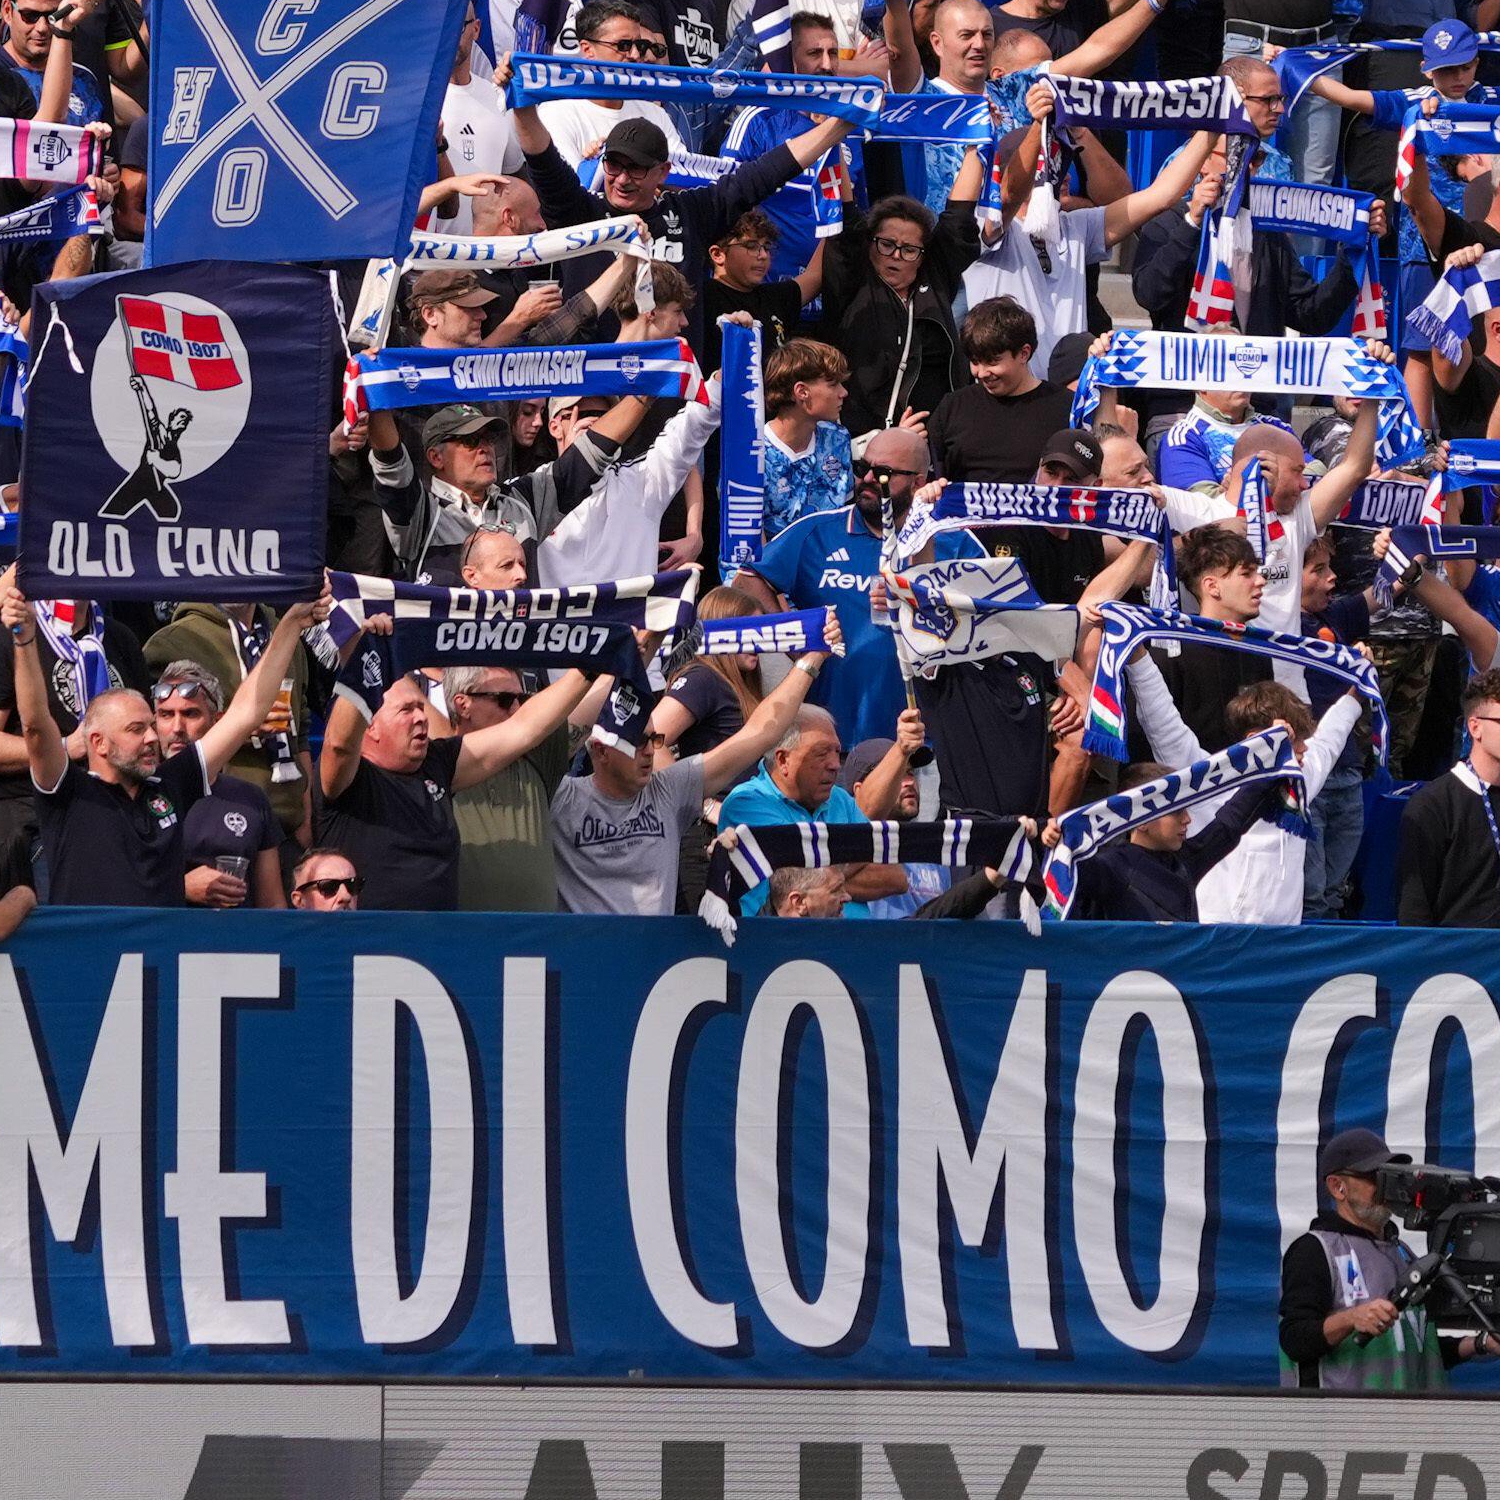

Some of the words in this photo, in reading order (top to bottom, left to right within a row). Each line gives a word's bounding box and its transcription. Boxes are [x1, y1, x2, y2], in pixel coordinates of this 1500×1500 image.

[523, 61, 682, 89] ULTRAS
[322, 61, 386, 139] C
[141, 330, 183, 353] COMO
[187, 341, 221, 358] 1907
[1160, 337, 1226, 381] COMO
[1276, 341, 1331, 386] 1907
[453, 353, 502, 389] SEMM
[502, 350, 586, 386] CUMASCH
[965, 484, 1060, 517] AVANTI
[48, 521, 134, 576] OLD
[436, 621, 526, 652] COMO
[535, 623, 610, 656] 1907
[578, 816, 619, 847] OLD
[352, 955, 559, 1346] DI
[625, 957, 1207, 1353] COMO
